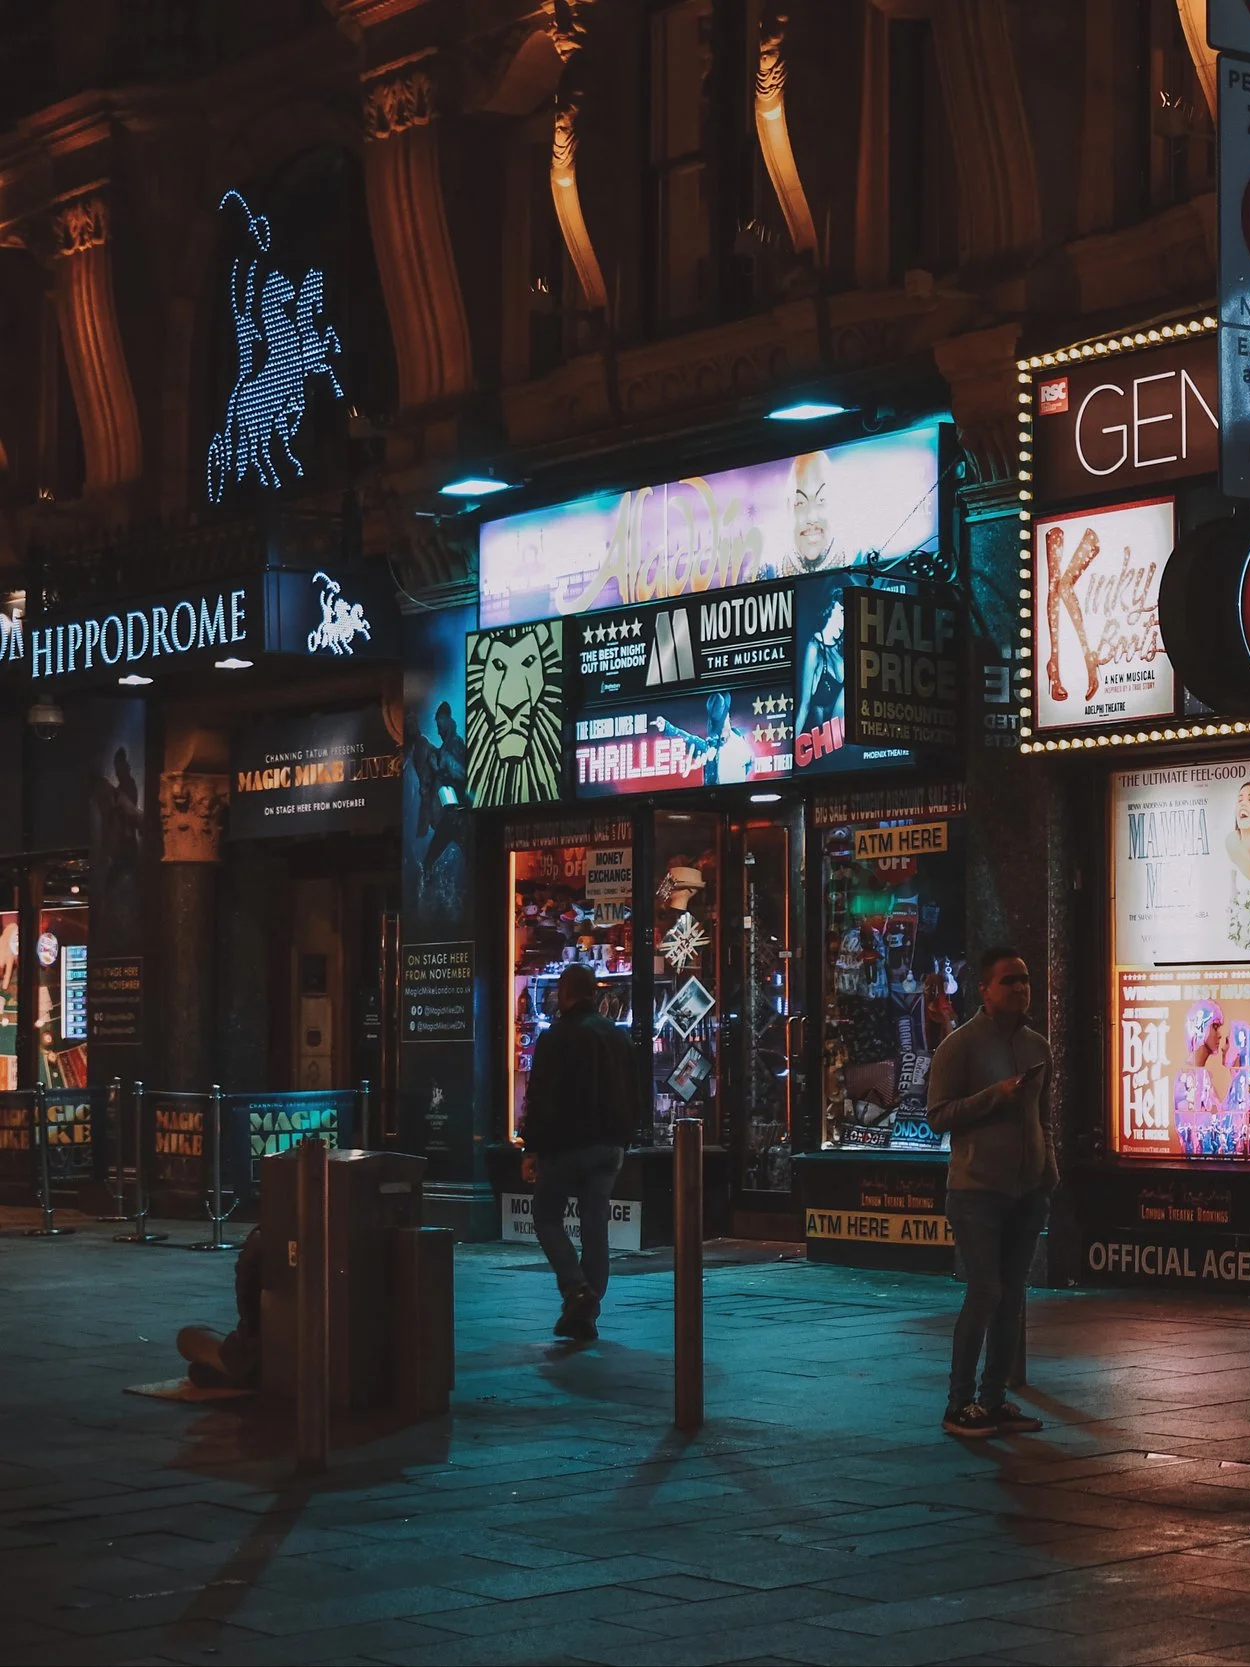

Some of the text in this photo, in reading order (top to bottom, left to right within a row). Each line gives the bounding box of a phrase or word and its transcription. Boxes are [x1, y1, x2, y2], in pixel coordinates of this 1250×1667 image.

[1041, 382, 1067, 403] RSC
[700, 591, 793, 642] MOTOWN
[860, 596, 954, 654] HALF
[31, 589, 247, 679] HIPPODROME
[598, 643, 646, 660] BEST NIGHT
[707, 647, 786, 669] THE MUSICAL
[581, 660, 609, 674] OUT IN
[860, 649, 957, 700] PRICE
[1110, 674, 1124, 684] NEW
[1126, 670, 1155, 682] MUSICAL
[860, 699, 957, 725] & DISCOUNTED
[1085, 701, 1125, 715] ADELPHI THEATRE
[860, 720, 957, 746] THEATRE TICKETS
[265, 743, 365, 764] CHANNING TATUM PRESENTS
[576, 737, 689, 784] THRILLER
[863, 751, 887, 760] PHOENIX
[237, 760, 345, 793] MAGIC MIKE
[1142, 771, 1188, 786] ULTIMATE
[264, 798, 366, 816] ON STAGE HERE FROM NOVEMBER
[857, 827, 943, 856] ATM HERE
[1128, 809, 1210, 860] MAMMA
[595, 851, 624, 865] MONEY
[588, 868, 631, 883] EXCHANGE
[594, 902, 625, 922] ATM
[408, 952, 469, 966] ON STAGE HERE
[405, 967, 471, 980] FROM NOVEMBER
[1122, 1019, 1171, 1072] Bat
[1122, 1073, 1170, 1140] Hell
[155, 1110, 204, 1131] MAGIC
[249, 1108, 338, 1132] MAGIC
[155, 1132, 204, 1157] MIKE
[1141, 1203, 1229, 1224] LONDON THEATRE BOOKINGS
[807, 1213, 842, 1235] ATM
[847, 1216, 890, 1238] HERE
[901, 1219, 938, 1241] ATM
[1088, 1240, 1197, 1278] OFFICIAL
